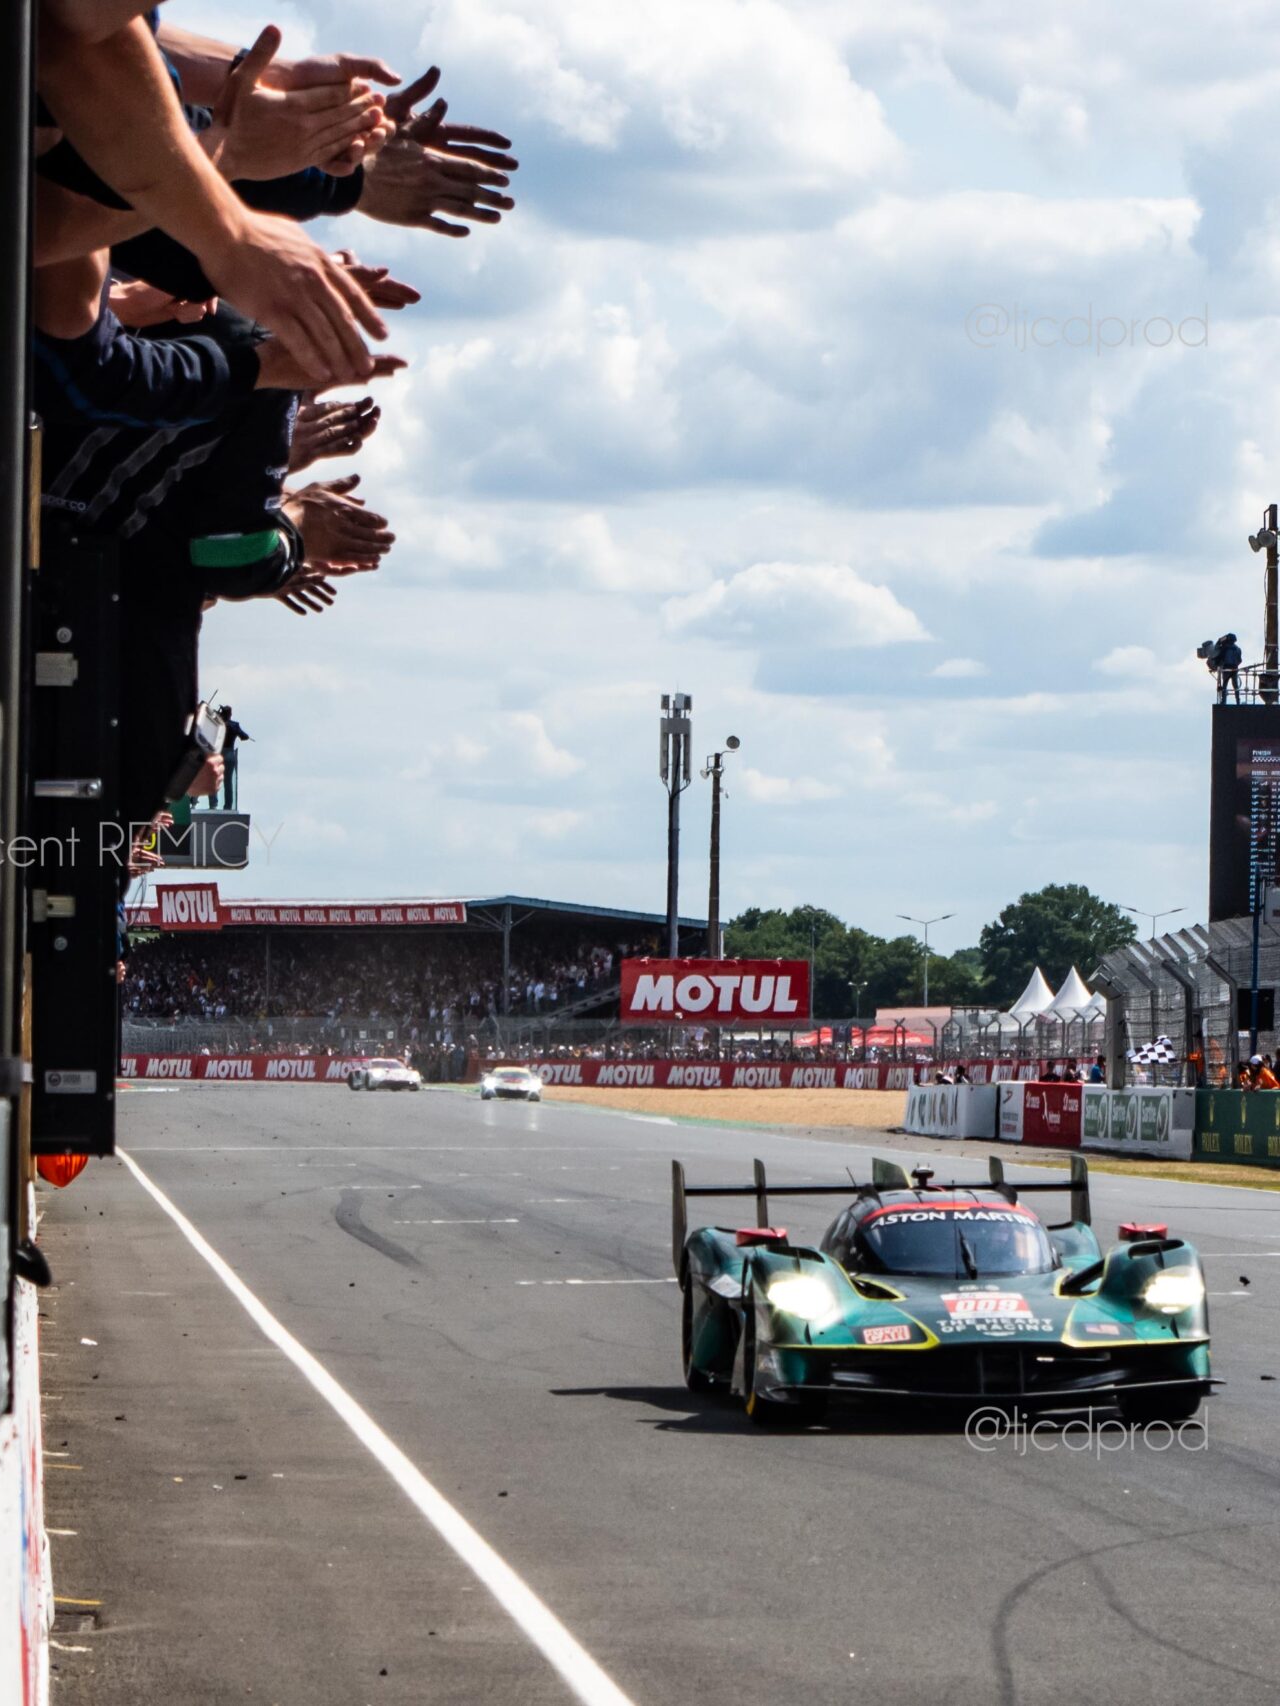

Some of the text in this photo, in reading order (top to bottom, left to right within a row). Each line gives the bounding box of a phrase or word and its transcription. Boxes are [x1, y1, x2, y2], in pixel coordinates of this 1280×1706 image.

[161, 889, 218, 923] MOTUL
[231, 906, 458, 922] MOTUL MOTUL MOTUL MOTUL MOTUL MOTUL MOTUL MOTUL MOTUL
[629, 974, 798, 1012] MOTUL
[145, 1058, 193, 1077] MOTUL
[204, 1059, 254, 1079] MOTUL
[265, 1059, 317, 1080] MOTUL
[596, 1064, 655, 1085] MOTUL
[667, 1065, 721, 1087] MOTUL
[732, 1066, 782, 1088] MOTUL
[790, 1067, 836, 1089] MOTUL
[843, 1067, 879, 1089] MOTUL
[871, 1210, 1037, 1230] ASTON MARTIN
[954, 1298, 1019, 1314] 009
[936, 1317, 1054, 1326] THE HEART
[940, 1324, 1054, 1333] OF RACING
